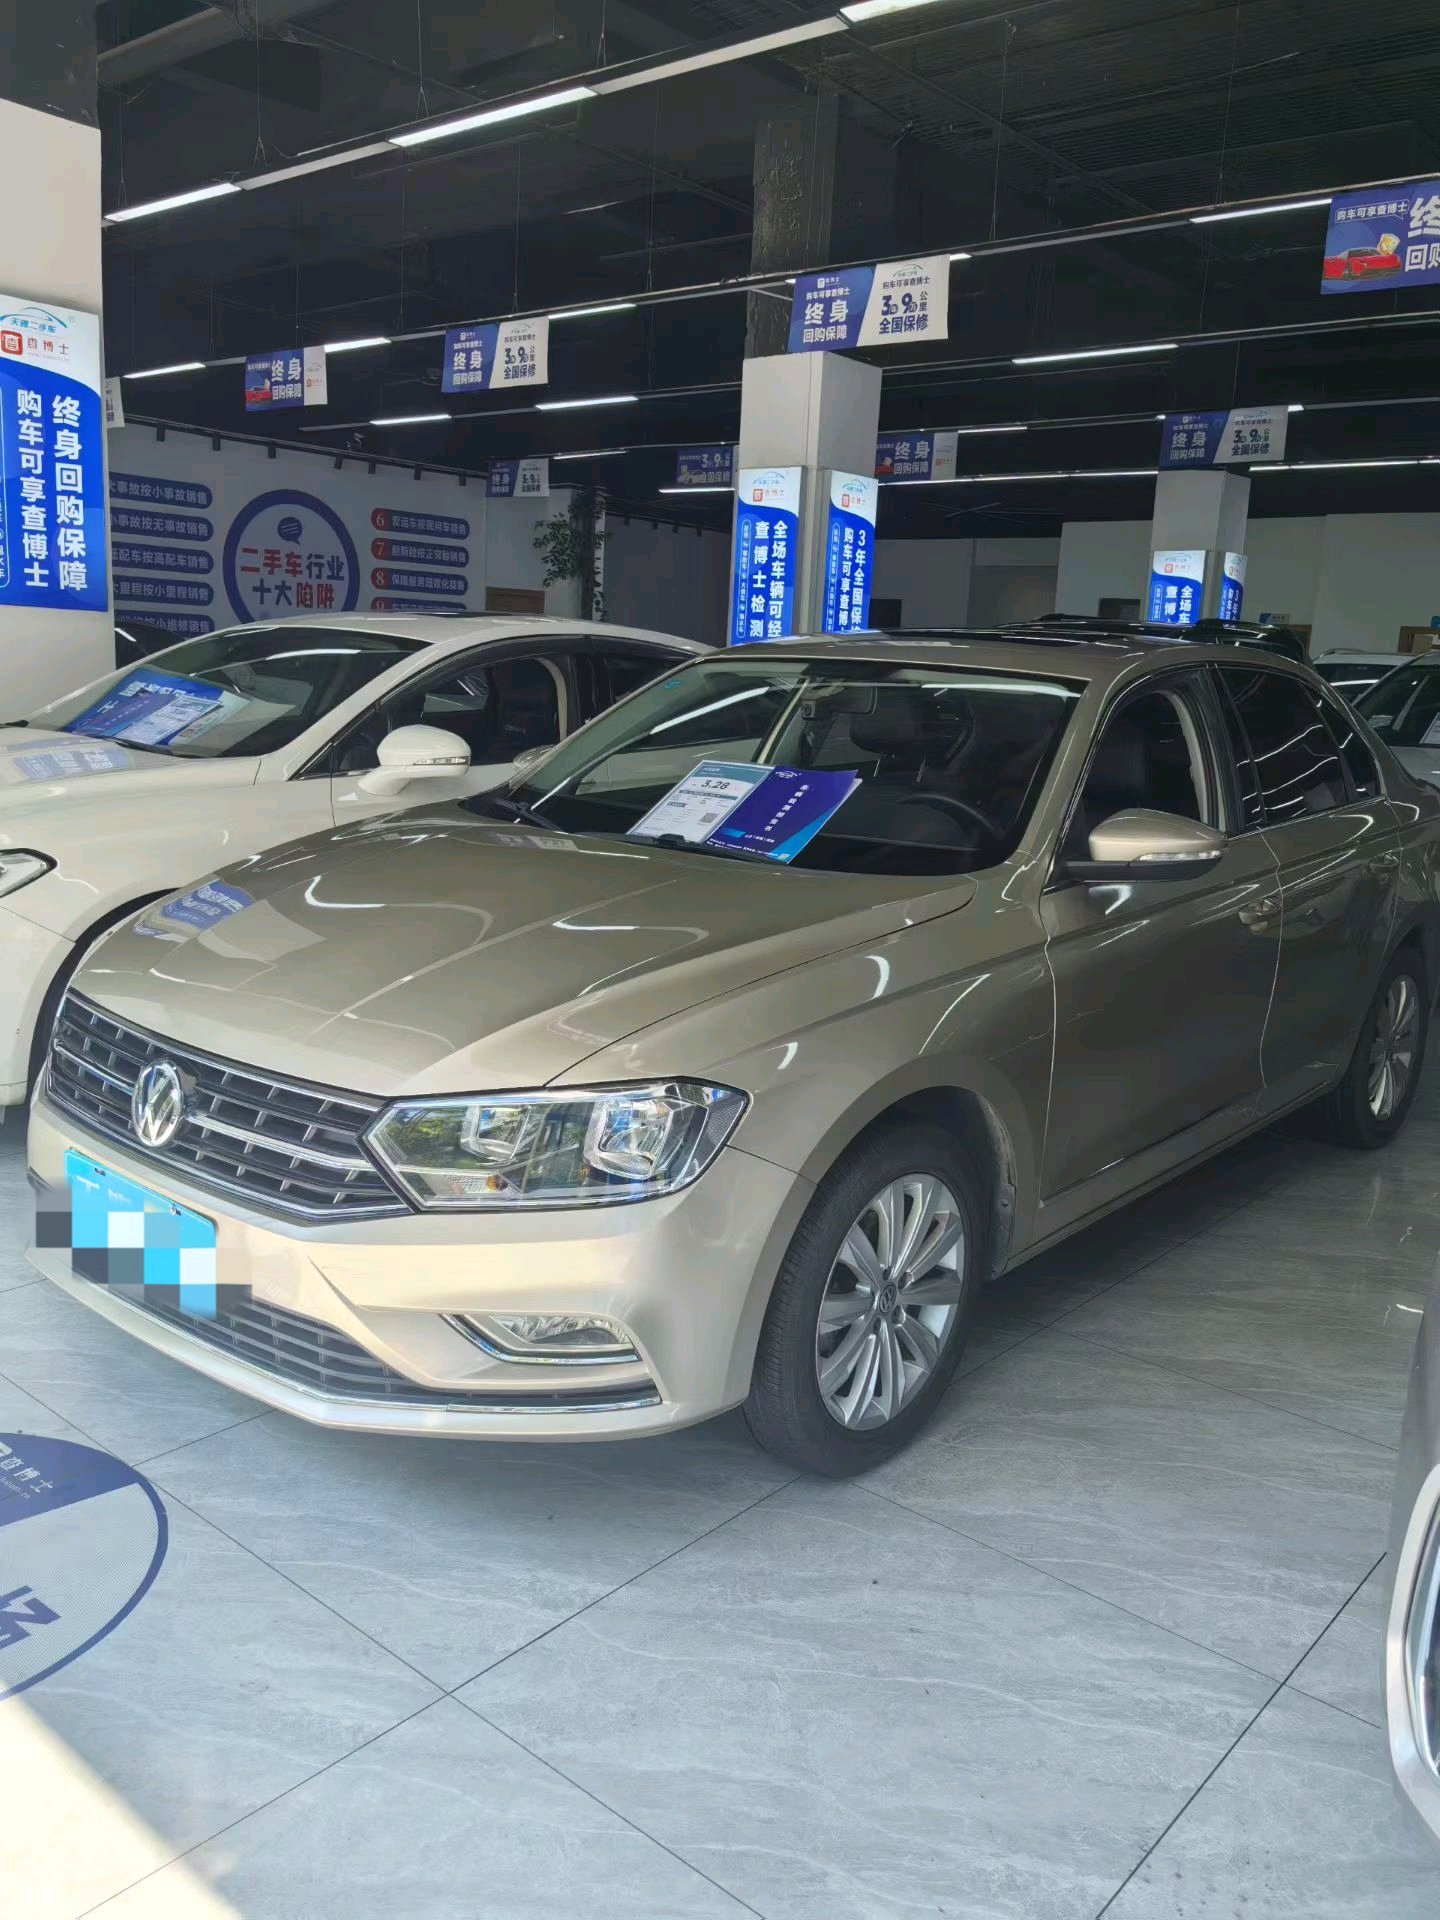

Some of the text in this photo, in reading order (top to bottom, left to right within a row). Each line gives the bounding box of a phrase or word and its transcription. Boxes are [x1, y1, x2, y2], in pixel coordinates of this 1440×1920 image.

[1337, 202, 1408, 221] 购车可享查博士
[806, 287, 851, 301] 购车可享查博士
[804, 299, 849, 326] 终身
[802, 324, 848, 344] 回购保障
[878, 313, 929, 335] 全国保修
[27, 337, 70, 355] 查博士
[271, 357, 302, 382] 终身
[452, 350, 483, 371] 终身
[452, 370, 483, 386] 回购保障
[503, 363, 537, 380] 全国保修
[272, 382, 303, 401] 回购保障
[1171, 430, 1207, 448] 终身
[894, 440, 931, 460] 终身
[1170, 447, 1206, 461] 回购保障
[1231, 442, 1271, 457] 全国保修
[893, 461, 929, 475] 回购保障
[17, 388, 49, 588] 购车可享查博士
[51, 395, 88, 591] 终身回购保障
[376, 512, 385, 527] 6
[376, 541, 385, 556] 7
[240, 547, 345, 581] 二手车行业
[376, 571, 384, 586] 8
[749, 520, 770, 638] 查博士检测
[767, 519, 789, 639] 全场车辆可经
[838, 527, 854, 631] 购车可享查博
[252, 577, 335, 609] 十大陷阱
[1164, 585, 1178, 622] 查博
[701, 779, 730, 790] 3.28
[0, 1456, 54, 1494] 查博士
